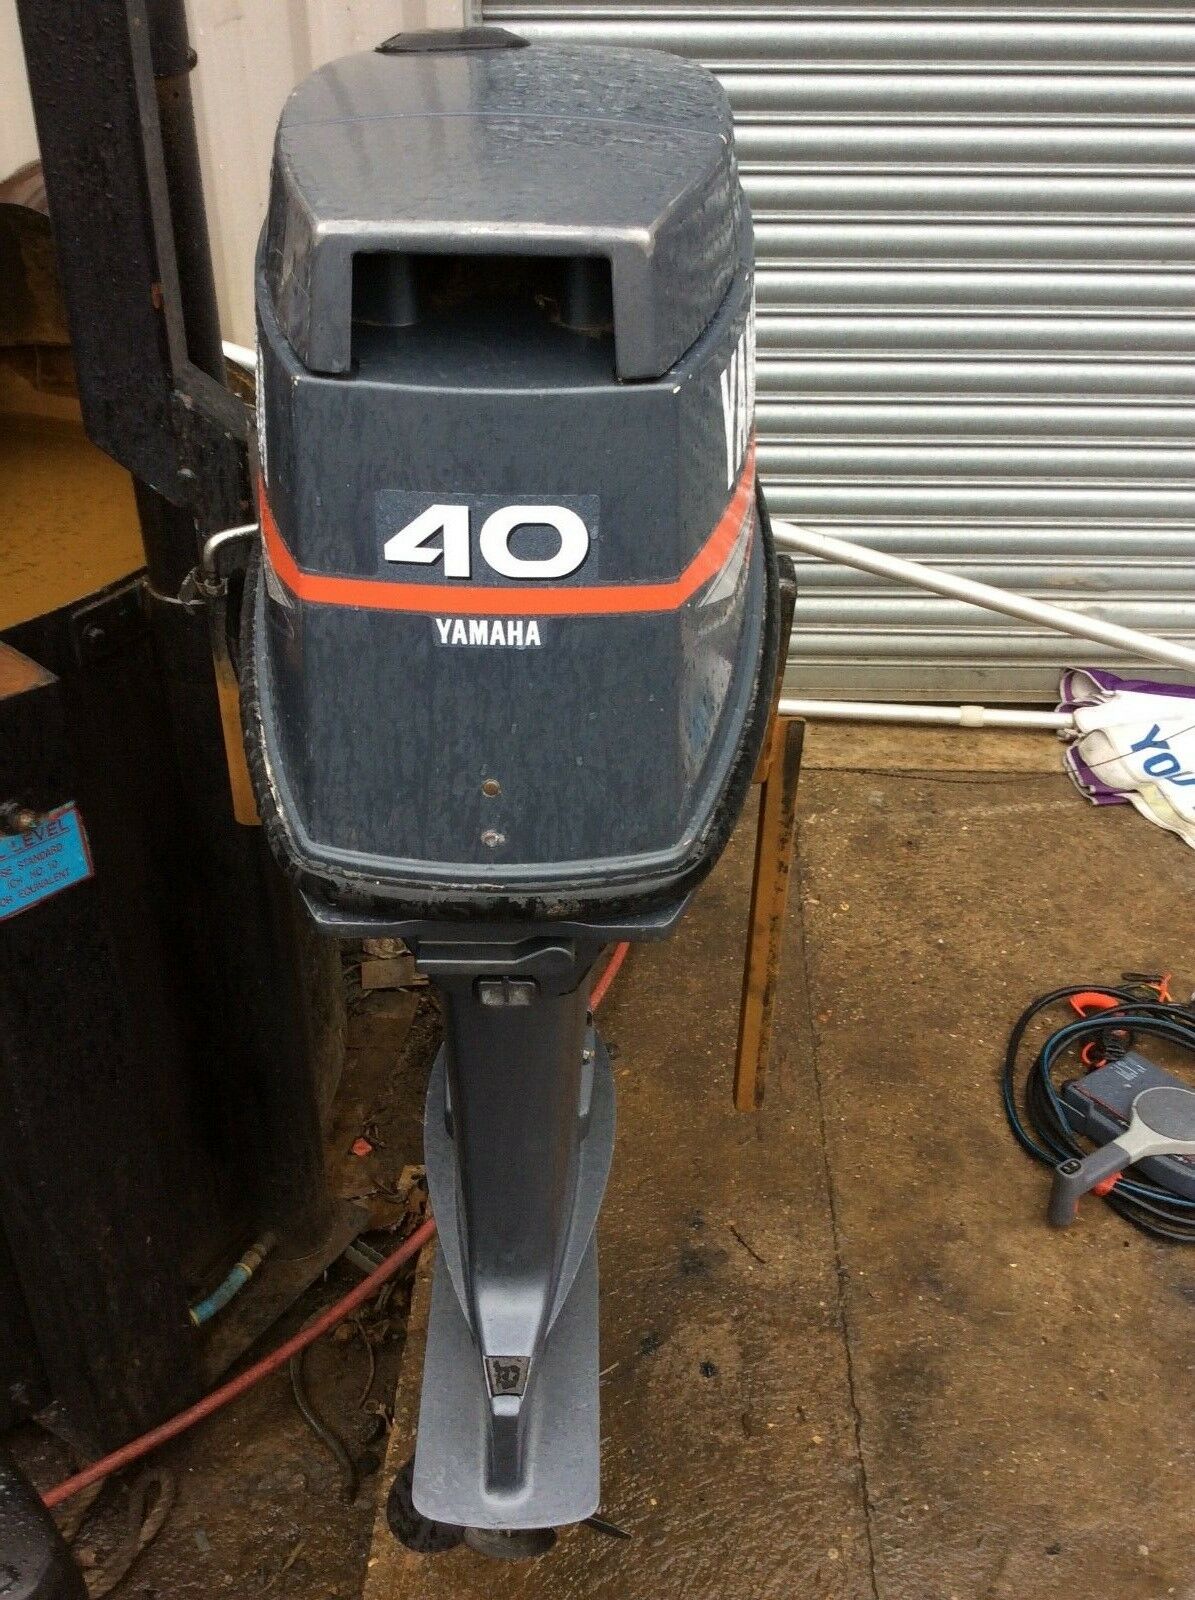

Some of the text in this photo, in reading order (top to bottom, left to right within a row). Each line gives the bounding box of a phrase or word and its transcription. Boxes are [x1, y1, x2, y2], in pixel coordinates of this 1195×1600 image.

[384, 503, 590, 581] 40
[435, 618, 541, 646] YAMAHA
[9, 819, 70, 850] LEVEL
